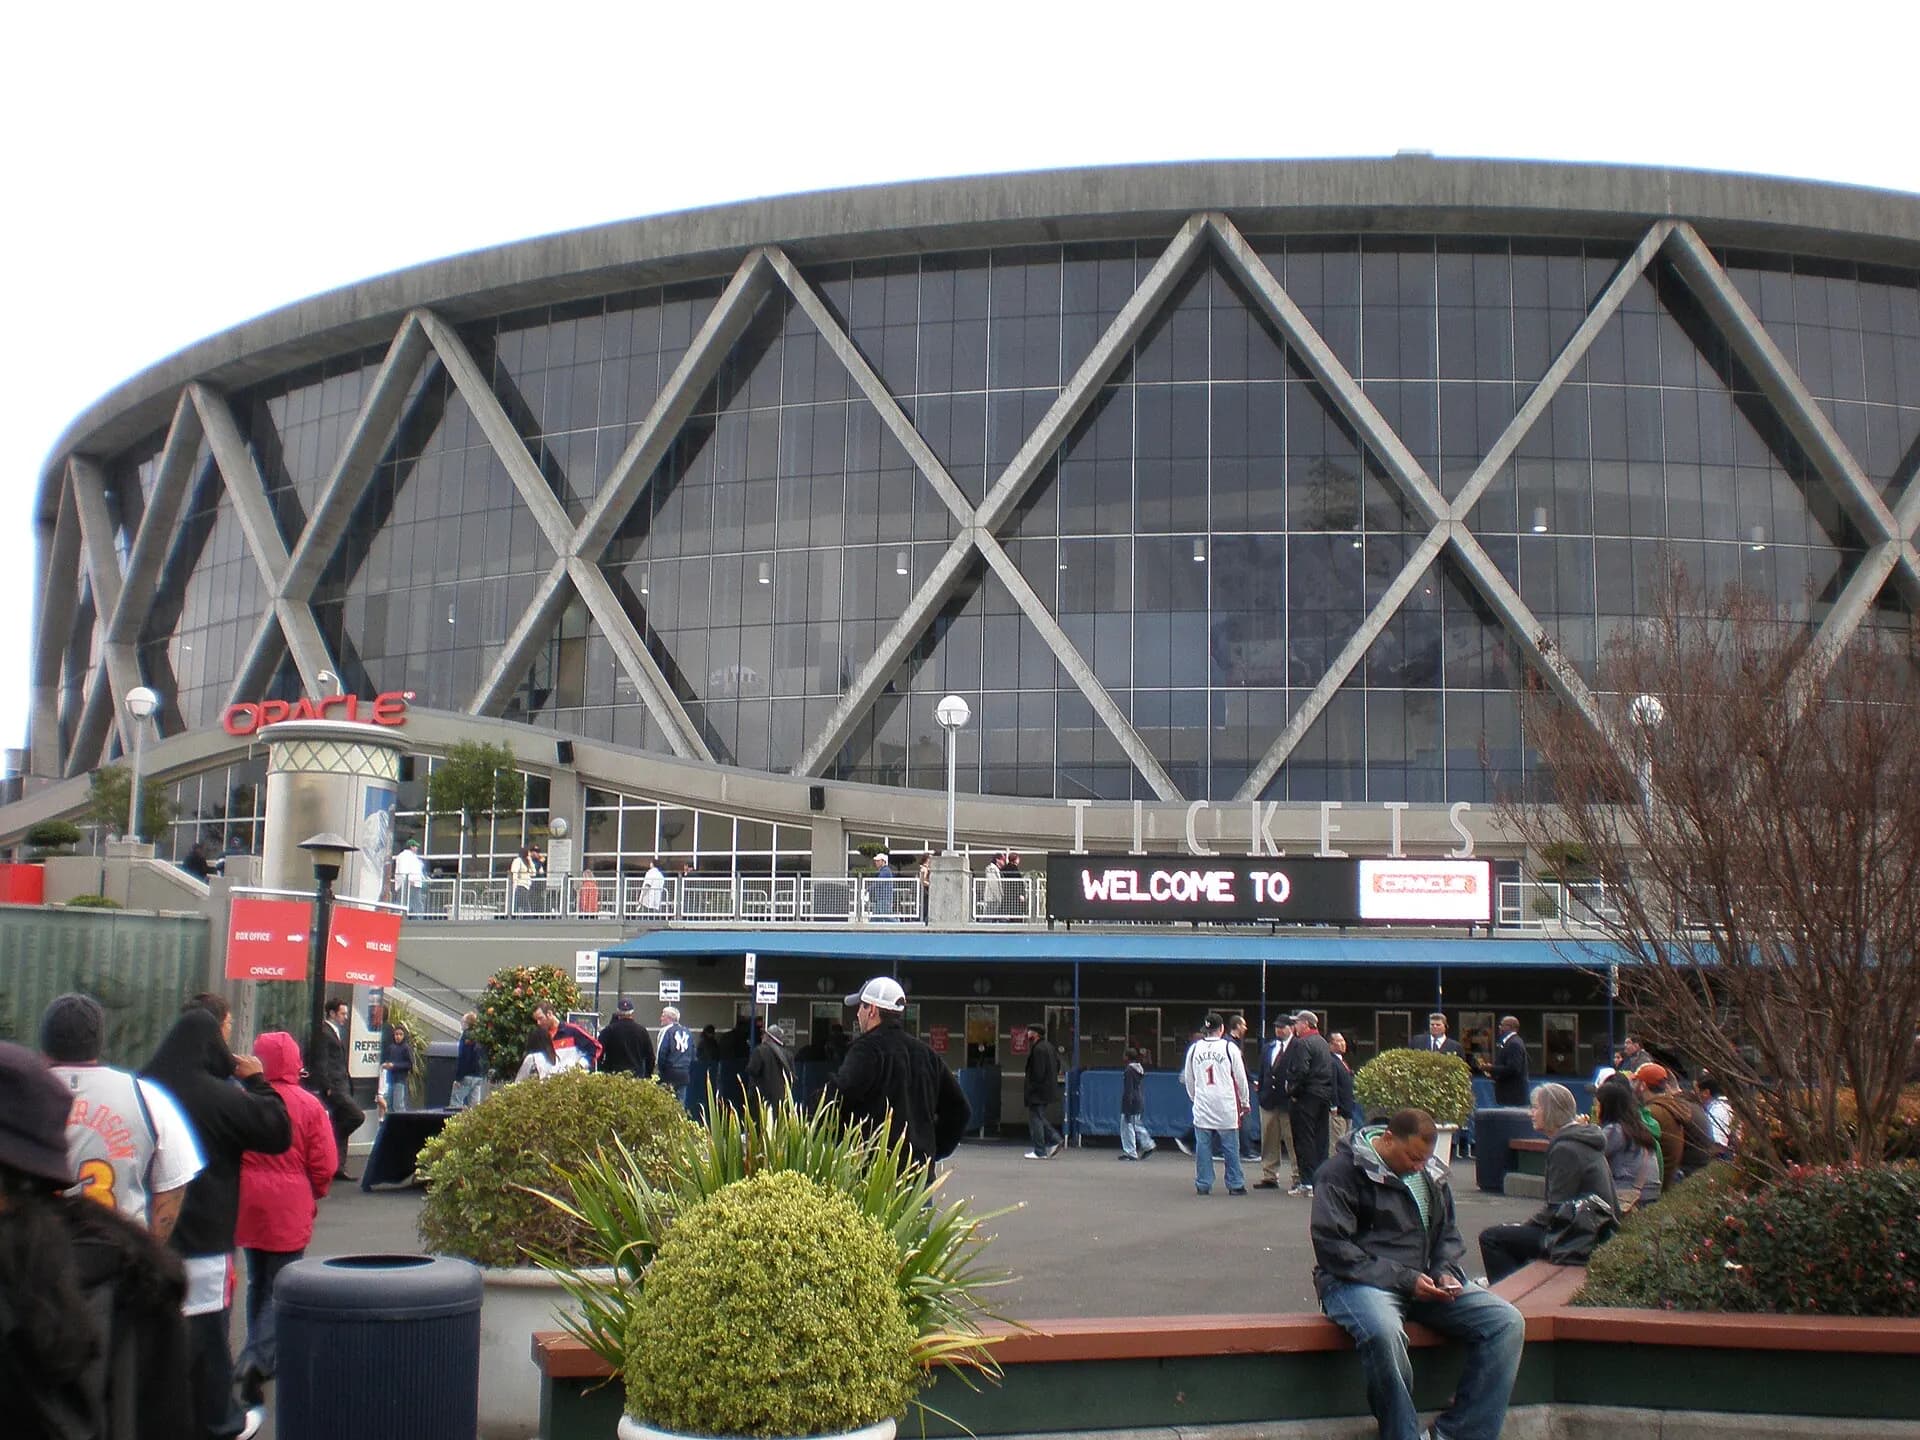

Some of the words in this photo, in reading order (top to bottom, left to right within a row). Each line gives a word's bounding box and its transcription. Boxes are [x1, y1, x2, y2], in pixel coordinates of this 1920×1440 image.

[223, 691, 407, 737] ORACLE
[1066, 799, 1476, 858] TICKETS
[1081, 869, 1236, 902] WELCOME
[1249, 871, 1291, 903] TO
[235, 931, 249, 941] BOX
[249, 931, 271, 942] OFFICE
[379, 942, 392, 953] CALL
[250, 966, 285, 976] ORACLE
[345, 971, 375, 982] ORACLE
[674, 1030, 690, 1053] NY
[1195, 1051, 1226, 1065] JACKSON
[1205, 1064, 1217, 1087] 1
